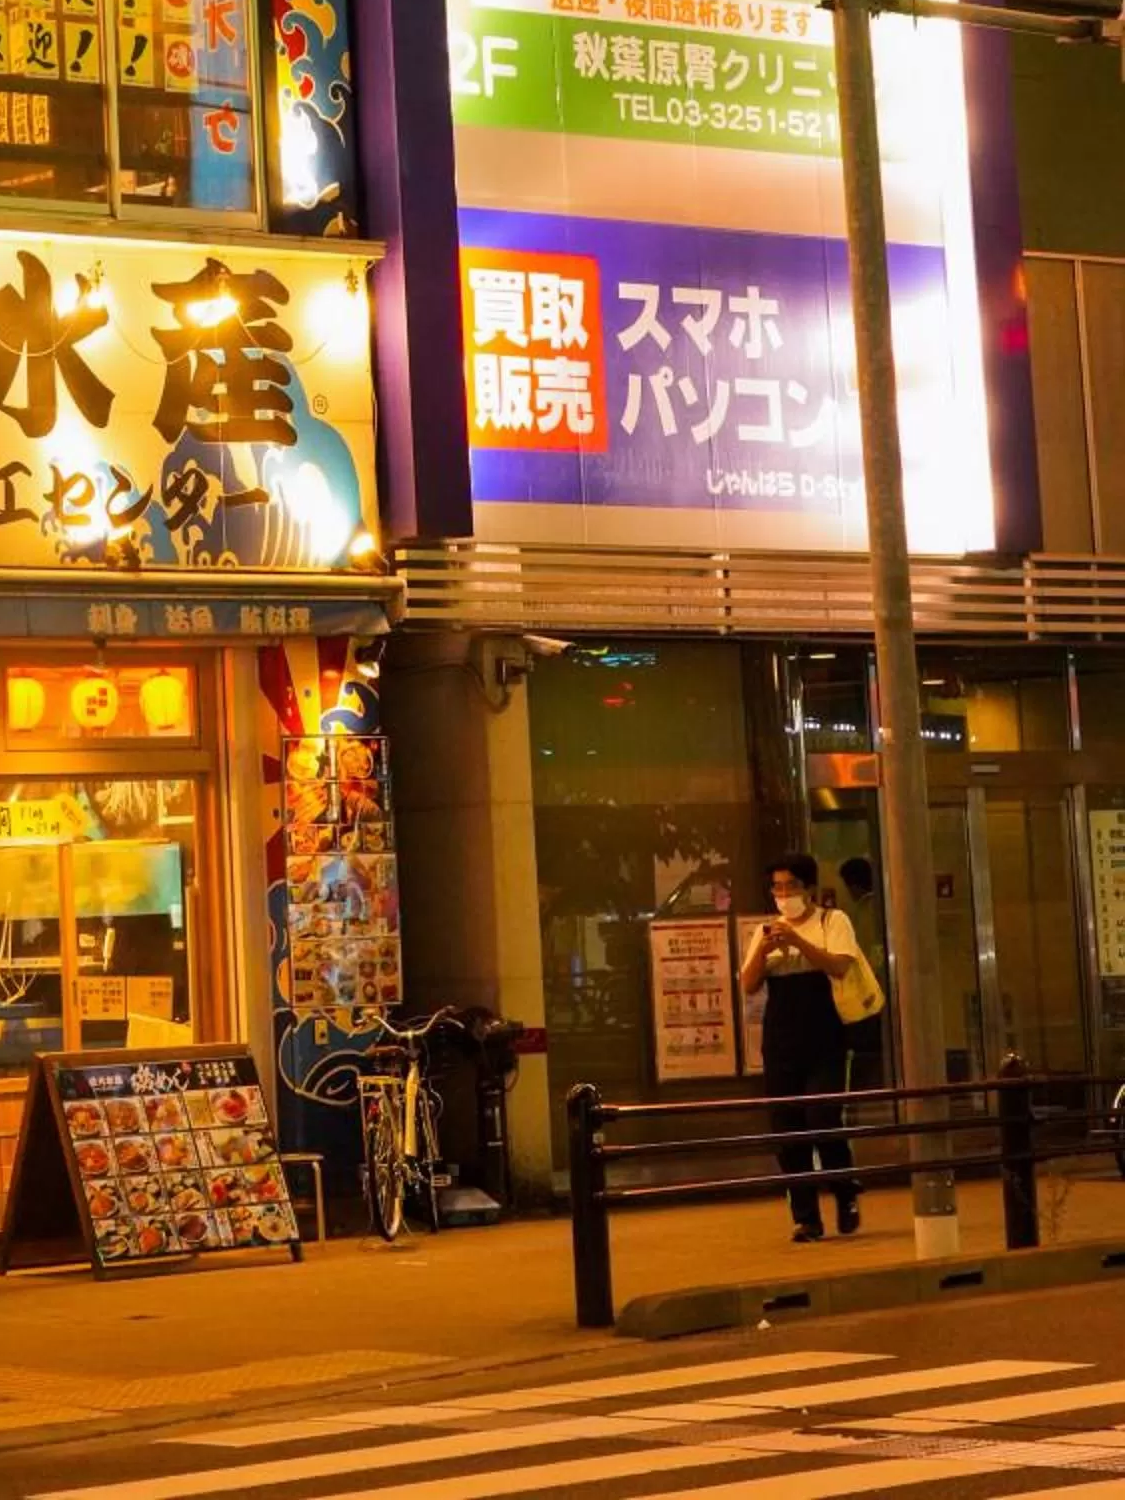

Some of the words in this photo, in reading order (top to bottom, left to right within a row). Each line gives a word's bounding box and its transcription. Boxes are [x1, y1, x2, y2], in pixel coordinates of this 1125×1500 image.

[450, 31, 520, 100] 2F
[467, 267, 590, 351] 買取
[617, 281, 784, 359] スマホ
[474, 352, 595, 435] 販売
[619, 366, 839, 449] パソコン
